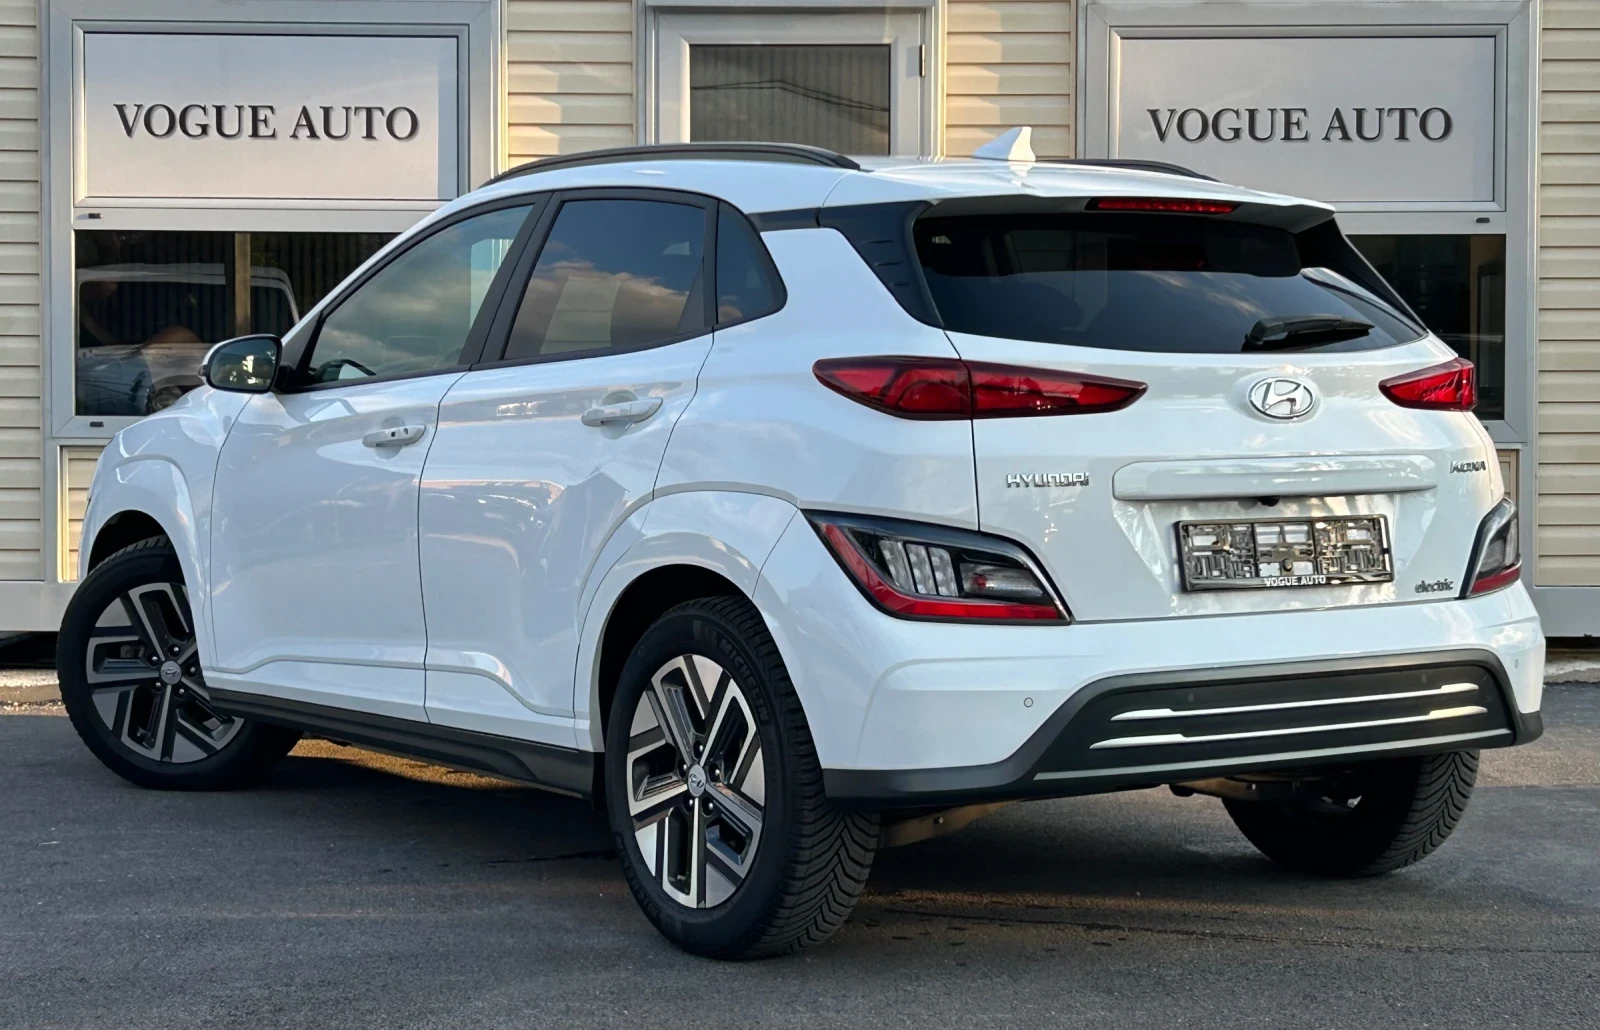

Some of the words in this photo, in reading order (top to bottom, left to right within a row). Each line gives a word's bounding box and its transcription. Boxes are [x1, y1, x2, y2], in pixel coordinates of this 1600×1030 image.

[113, 103, 277, 139] VOGUE
[289, 105, 419, 140] AUTO
[1147, 107, 1310, 142] VOGUE
[1322, 107, 1453, 142] AUTO
[1006, 472, 1089, 488] HYUNDAI
[1264, 576, 1298, 587] VOGUE
[1300, 574, 1326, 585] AUTO
[1414, 578, 1454, 593] electric
[718, 638, 770, 722] MICHELIN
